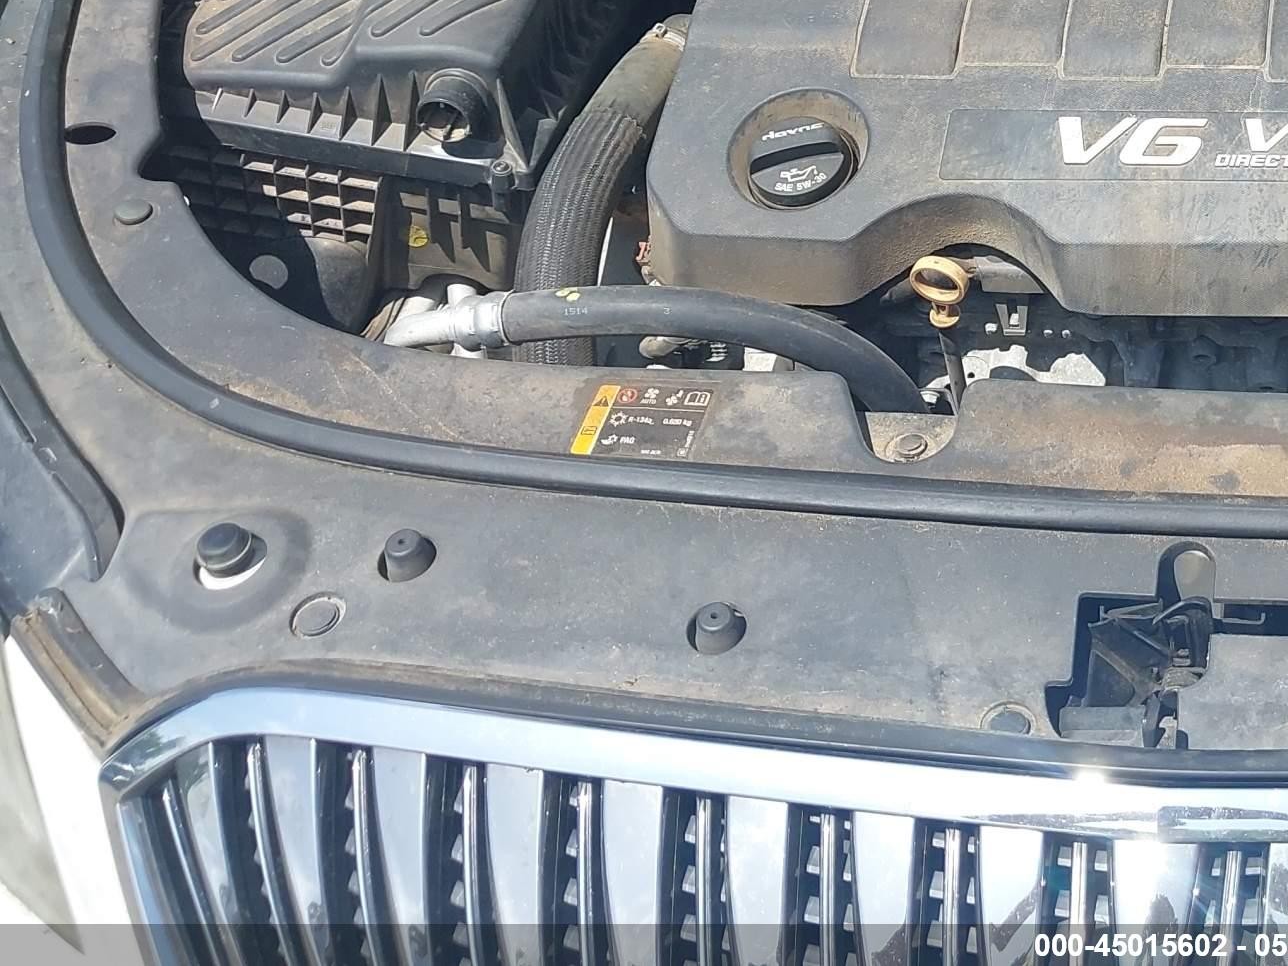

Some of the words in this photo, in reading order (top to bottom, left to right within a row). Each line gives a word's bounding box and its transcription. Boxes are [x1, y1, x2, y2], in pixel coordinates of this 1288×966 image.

[1058, 116, 1209, 166] V6
[774, 181, 794, 192] SAE
[796, 172, 828, 191] 5W-30
